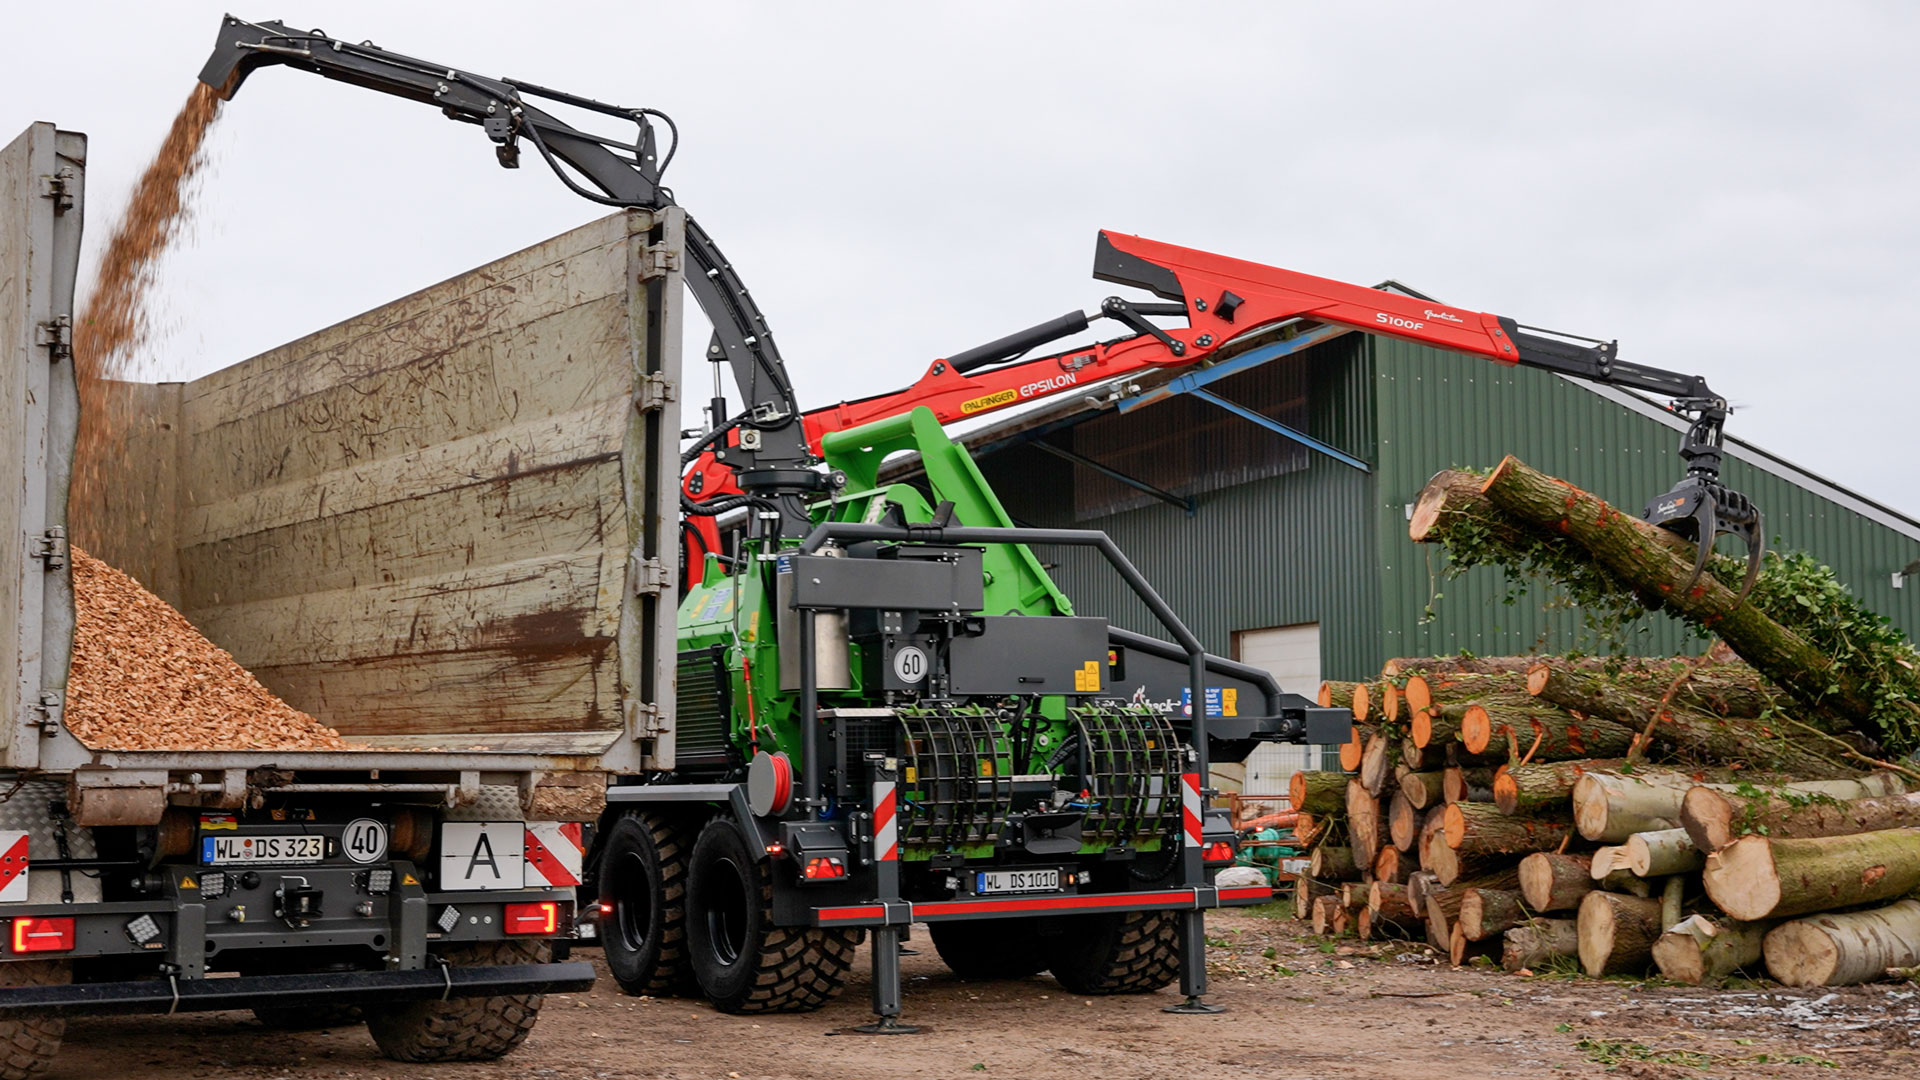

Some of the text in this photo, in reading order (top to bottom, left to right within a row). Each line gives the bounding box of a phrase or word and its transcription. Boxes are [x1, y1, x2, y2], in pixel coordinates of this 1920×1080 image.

[1376, 313, 1424, 330] S100F
[963, 373, 1076, 412] PALFINGER EPSILON
[902, 654, 920, 675] 60
[216, 839, 241, 859] WL
[255, 839, 280, 858] DS
[285, 838, 321, 858] 323
[351, 826, 378, 854] 40
[464, 832, 502, 880] A
[987, 875, 1001, 889] WL
[1010, 873, 1025, 888] DS
[1028, 872, 1057, 888] 1010
